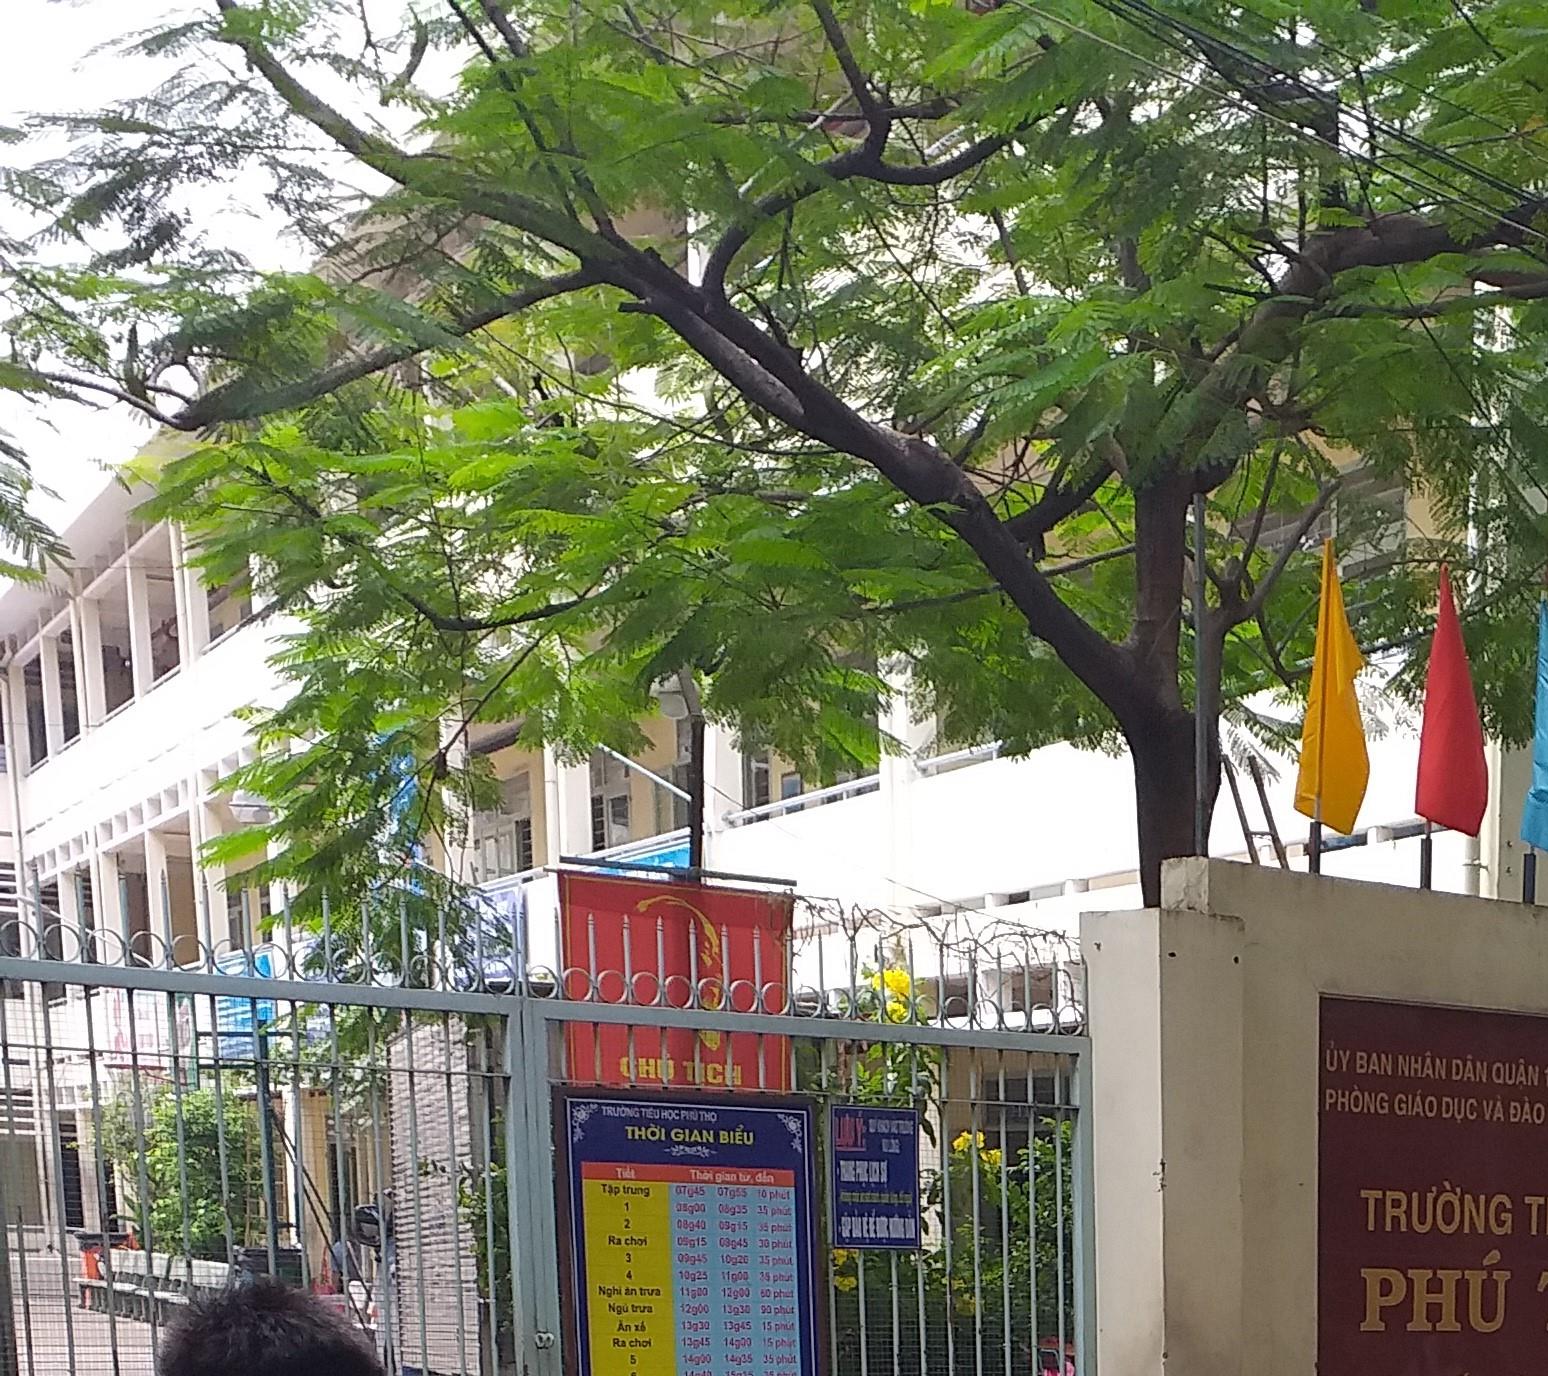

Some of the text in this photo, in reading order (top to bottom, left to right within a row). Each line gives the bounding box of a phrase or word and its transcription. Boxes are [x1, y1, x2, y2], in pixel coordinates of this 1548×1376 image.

[1326, 1040, 1350, 1072] ỦY
[1356, 1052, 1392, 1075] BAN
[1398, 1051, 1446, 1080] NHÂN
[1452, 1055, 1487, 1082] DÂN
[1492, 1059, 1538, 1089] QUẬN
[1325, 1085, 1389, 1113] PHÒNG
[1394, 1090, 1437, 1118] GIÁO
[1442, 1098, 1477, 1123] DỤC
[1483, 1095, 1504, 1121] VÀ
[1509, 1097, 1545, 1124] ĐÀO
[625, 1124, 754, 1145] THỜI GIAN BIỂU
[601, 1184, 621, 1197] Tập
[624, 1186, 650, 1197] trung
[1360, 1180, 1513, 1235] TRƯỜNG
[624, 1219, 631, 1229] 2
[608, 1235, 648, 1246] Ra chơi
[625, 1253, 632, 1263] 3
[1360, 1250, 1511, 1333] PHÚ
[774, 1304, 795, 1317] phút
[612, 1338, 652, 1348] Ra chơi
[630, 1355, 637, 1365] 5
